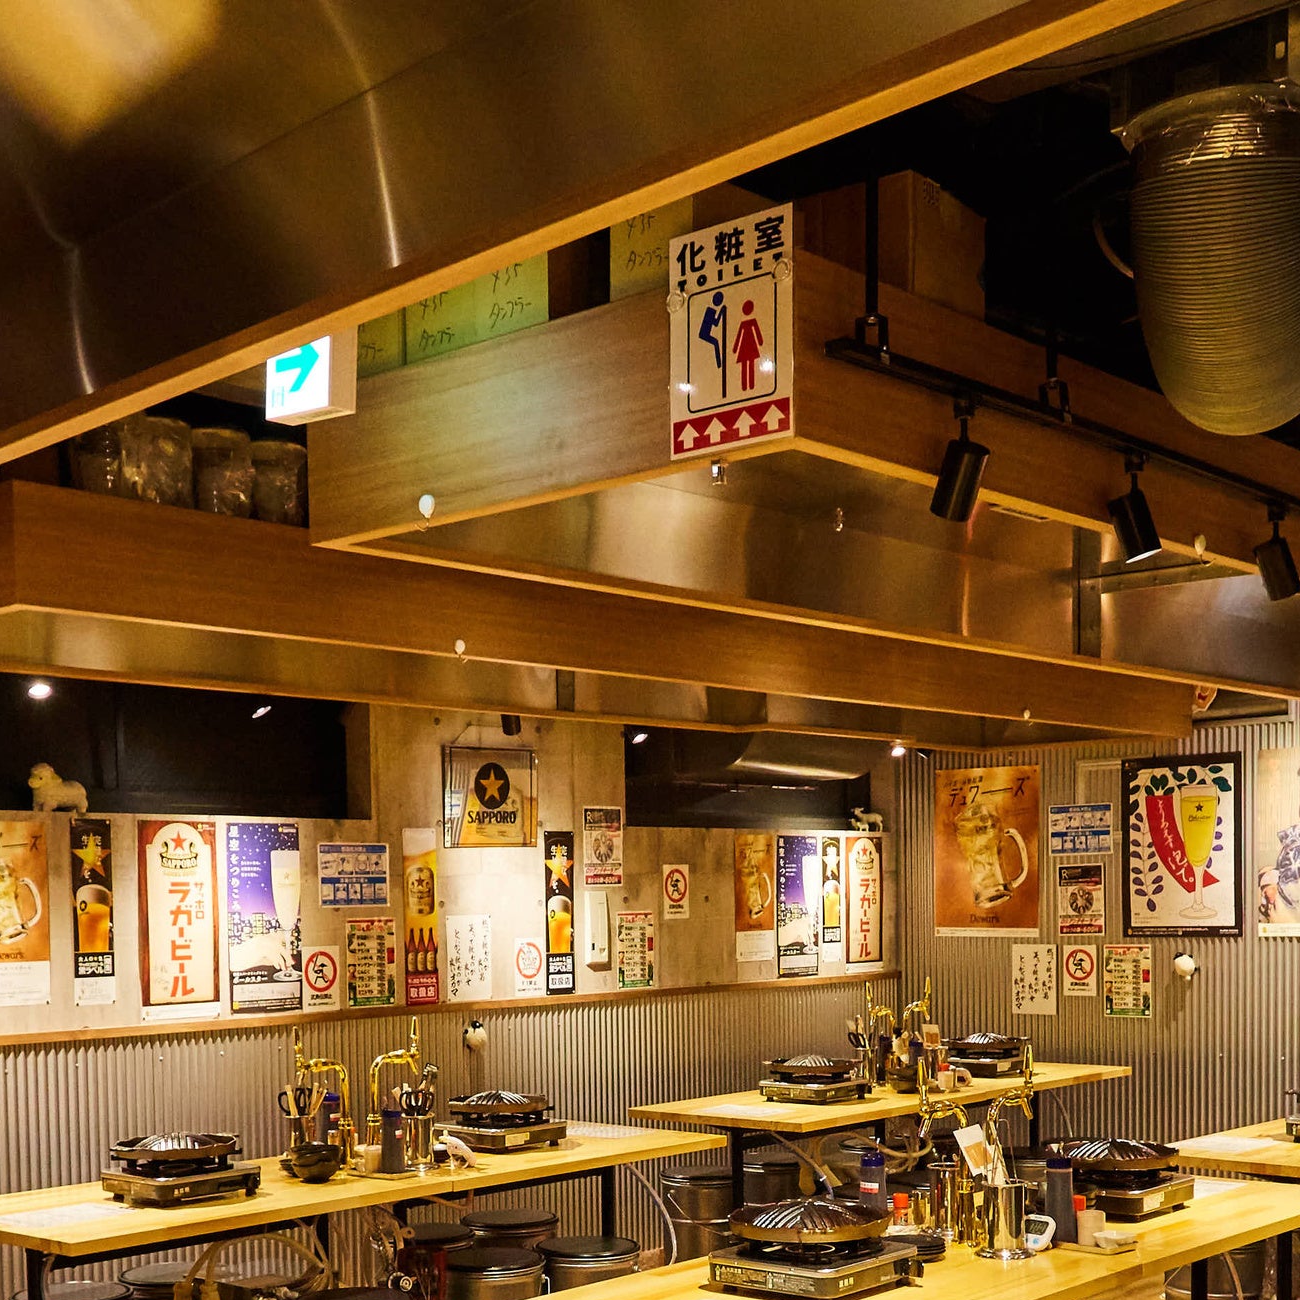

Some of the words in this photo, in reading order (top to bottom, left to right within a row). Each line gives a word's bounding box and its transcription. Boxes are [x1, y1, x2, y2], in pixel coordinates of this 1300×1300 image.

[676, 214, 785, 276] 化粧室
[677, 251, 783, 292] TOILET
[467, 809, 517, 825] SAPPORO
[161, 856, 198, 870] SAPPORO
[194, 882, 206, 920] サッポロ
[859, 878, 872, 958] ラガービール
[168, 881, 196, 998] ラガービール
[410, 986, 436, 998] 取扱店
